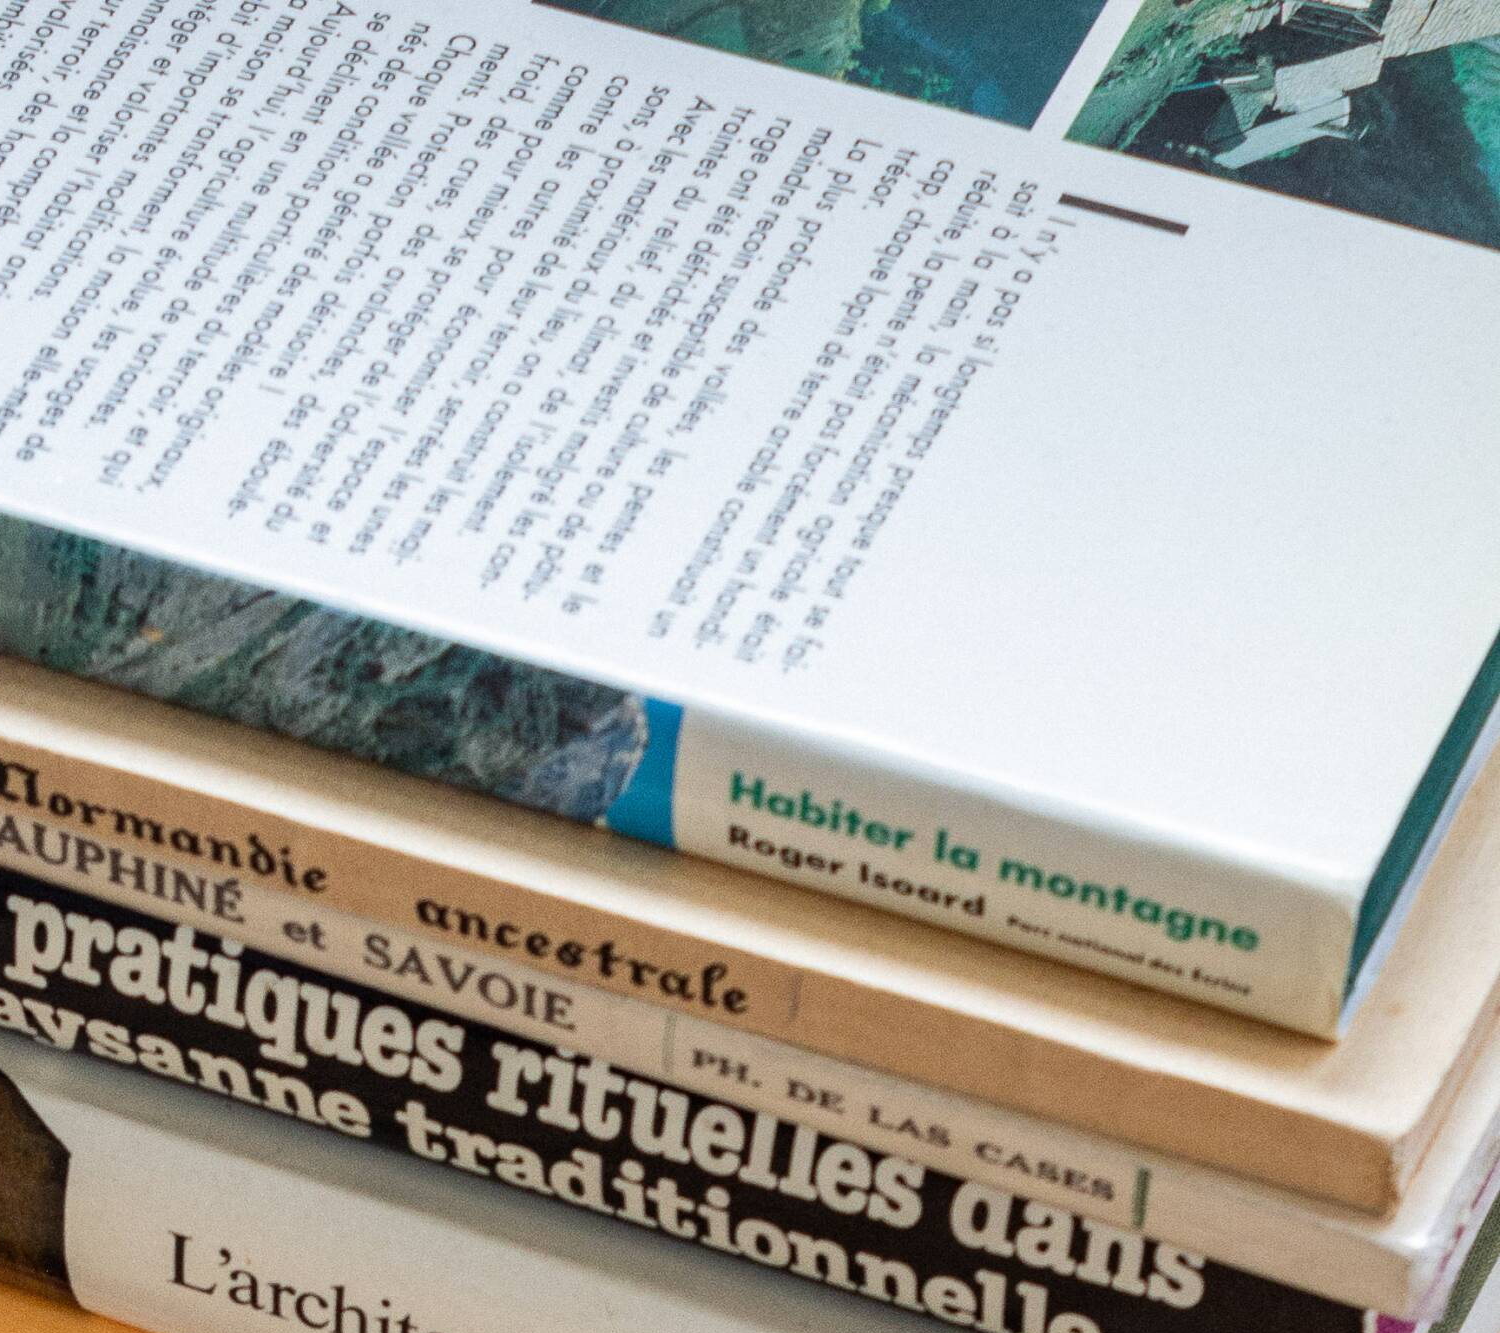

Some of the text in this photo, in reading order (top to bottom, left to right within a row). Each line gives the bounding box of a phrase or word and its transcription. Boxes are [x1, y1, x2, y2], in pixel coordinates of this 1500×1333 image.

[40, 19, 110, 83] terroir,
[147, 56, 172, 76] et
[217, 85, 245, 107] se
[235, 13, 296, 82] maison
[16, 90, 58, 124] des
[49, 123, 86, 144] la
[66, 103, 90, 123] et
[84, 81, 156, 165] valoriser
[19, 167, 101, 251] l'habitat
[27, 31, 242, 301] d'importantes modifications.
[119, 111, 232, 236] transforment,
[14, 0, 357, 462] Aujourd'hui, l'agriculture évolue, les usages de
[83, 11, 392, 429] se déclinent en une multitude de variantes.
[96, 21, 431, 488] nés des conditions particulières du terroir, et qui
[104, 243, 142, 265] la
[134, 33, 478, 493] Chaque vallée a généré des modèles originaux,
[50, 268, 114, 340] maison
[560, 137, 883, 615] La plus profonde des vallées, les pentes et le
[728, 823, 985, 917] Roger Isoard
[729, 771, 1260, 953] Habiter la montagne
[282, 921, 327, 951] et
[364, 932, 576, 1032] SAVOIE
[417, 897, 749, 1015] ancestrale
[6, 893, 466, 1095] pratiques
[491, 1044, 926, 1234] rituelles
[949, 1178, 1207, 1310] dans
[690, 1048, 1117, 1205] PH. DE LAS CASES
